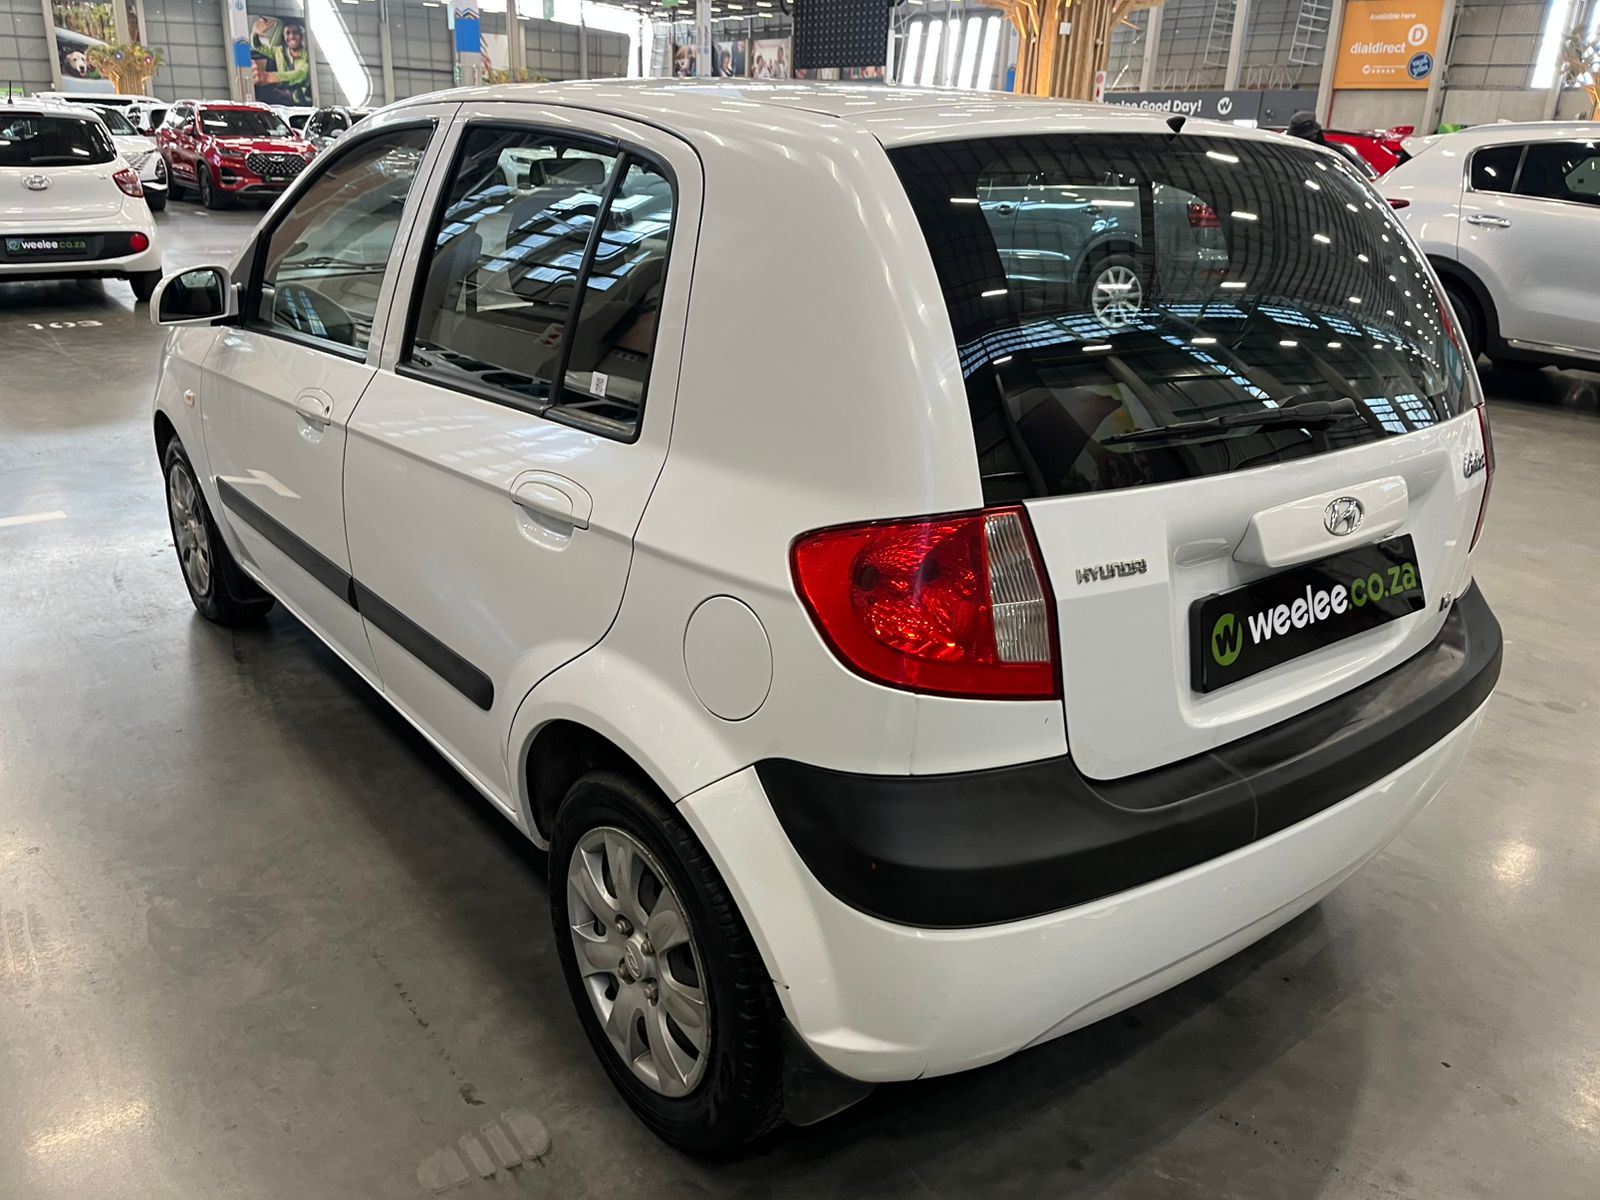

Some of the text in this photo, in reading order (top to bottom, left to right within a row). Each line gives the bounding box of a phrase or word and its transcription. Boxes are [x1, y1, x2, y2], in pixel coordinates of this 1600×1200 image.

[1400, 12, 1417, 20] here
[1350, 42, 1406, 54] dialdirect
[1140, 99, 1171, 112] Good
[1172, 99, 1202, 115] Day!
[1075, 558, 1147, 585] HYUNDAI
[1248, 562, 1417, 644] weelee.co.za
